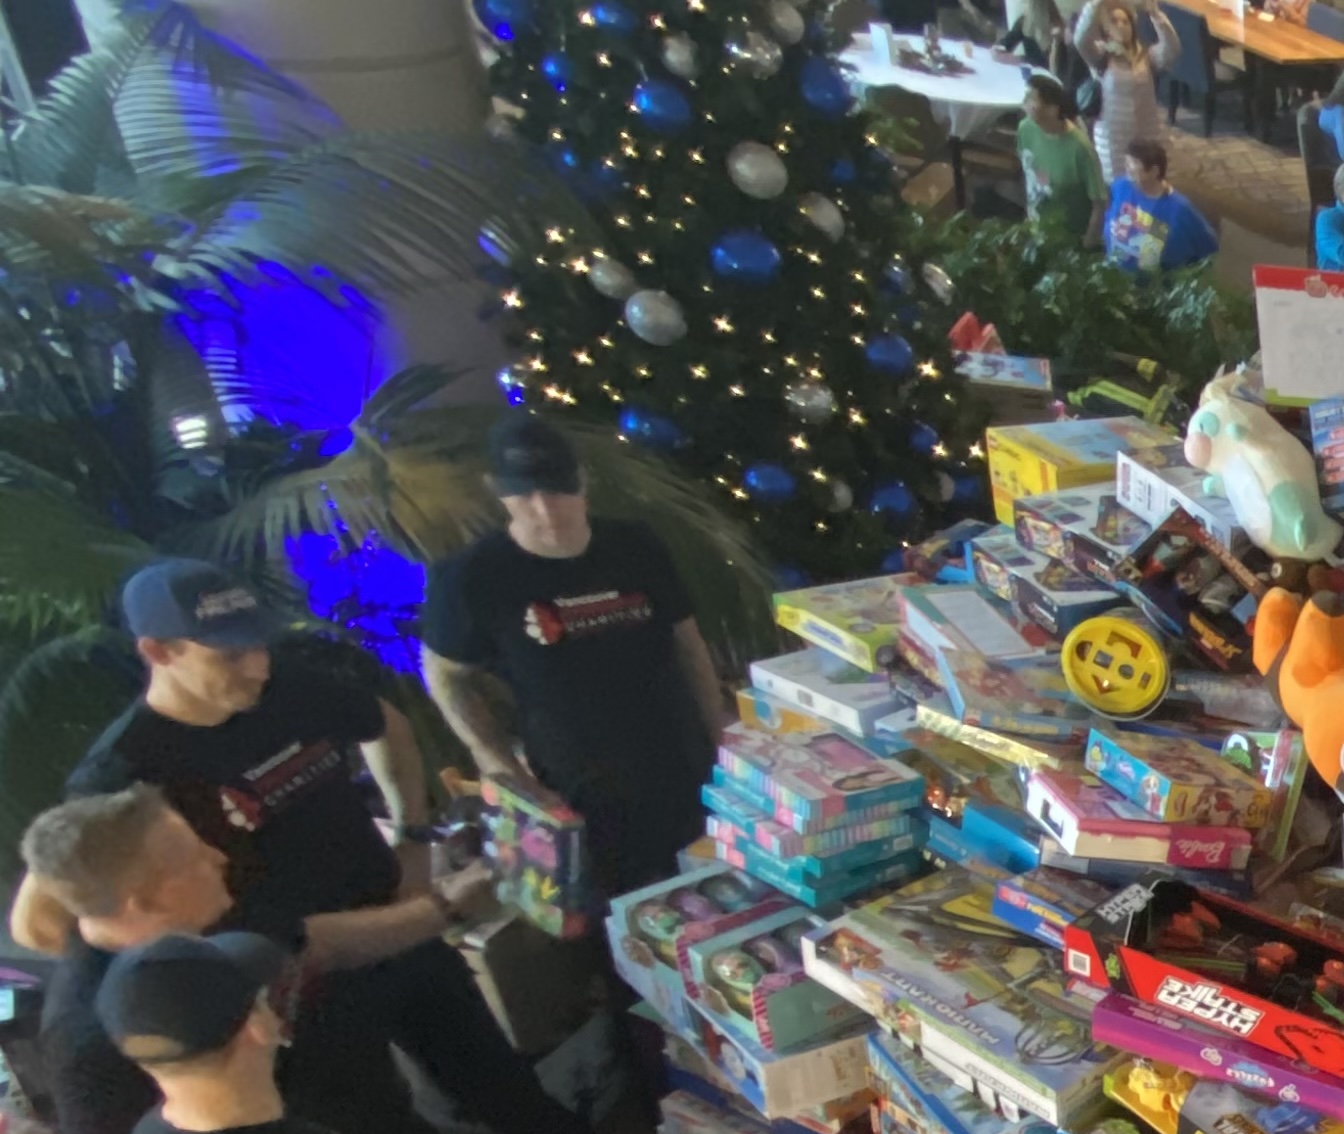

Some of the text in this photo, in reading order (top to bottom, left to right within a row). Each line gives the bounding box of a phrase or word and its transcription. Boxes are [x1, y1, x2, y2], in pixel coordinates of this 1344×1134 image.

[1175, 838, 1225, 863] Barbie
[879, 970, 1000, 1045] MARIO KART
[1155, 989, 1251, 1034] HYPER
[1165, 977, 1261, 1021] STRIKE
